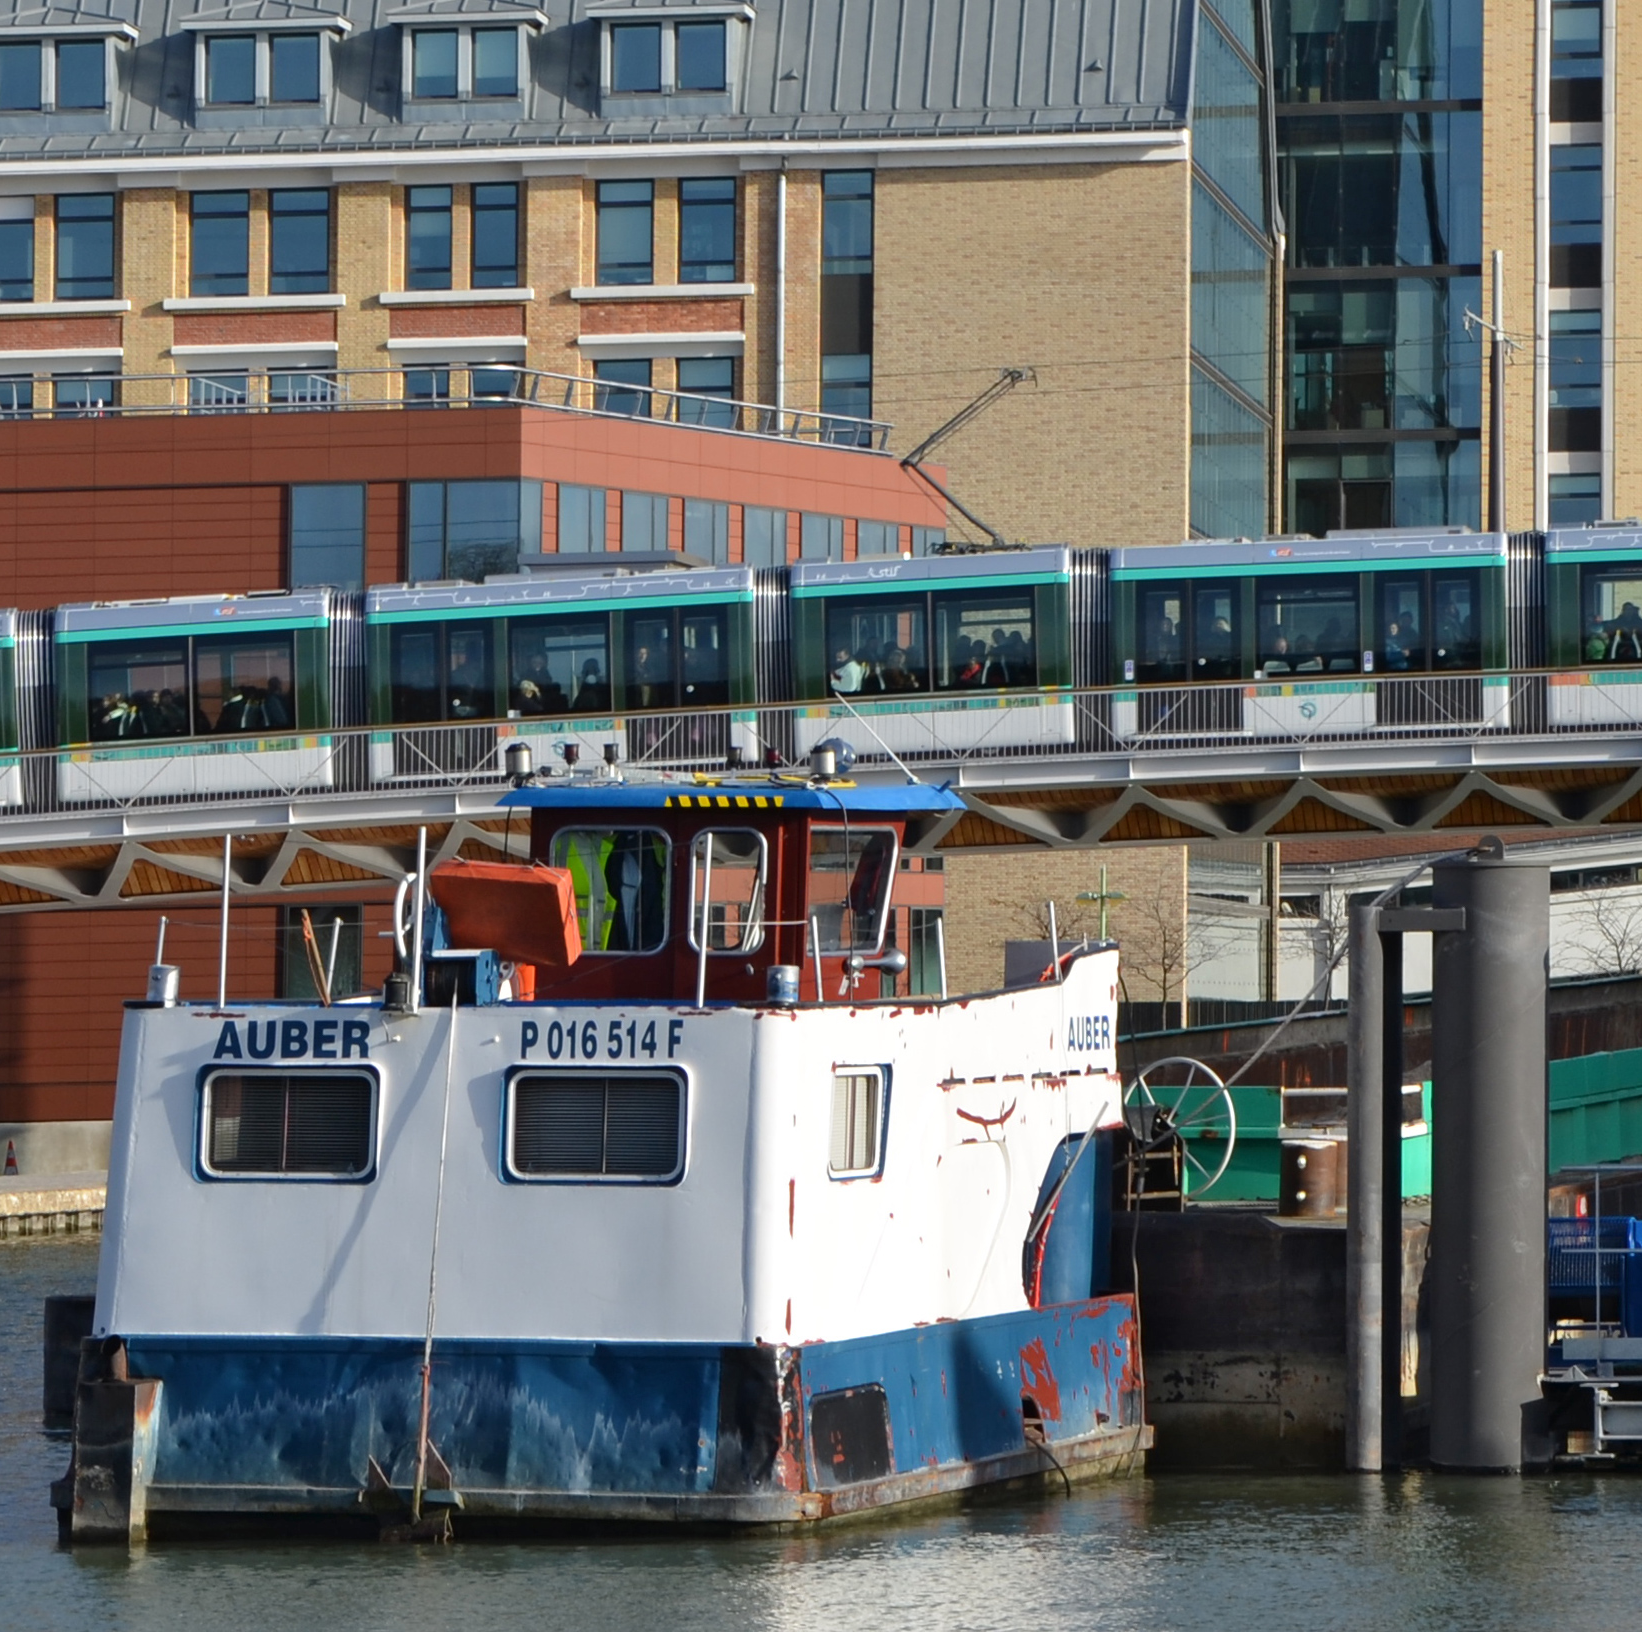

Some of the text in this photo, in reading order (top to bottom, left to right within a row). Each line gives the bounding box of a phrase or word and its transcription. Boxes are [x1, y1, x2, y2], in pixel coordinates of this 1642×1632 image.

[212, 1019, 371, 1060] AUBER
[520, 1019, 684, 1060] P 016 514 F
[1068, 1016, 1110, 1052] AUBER
